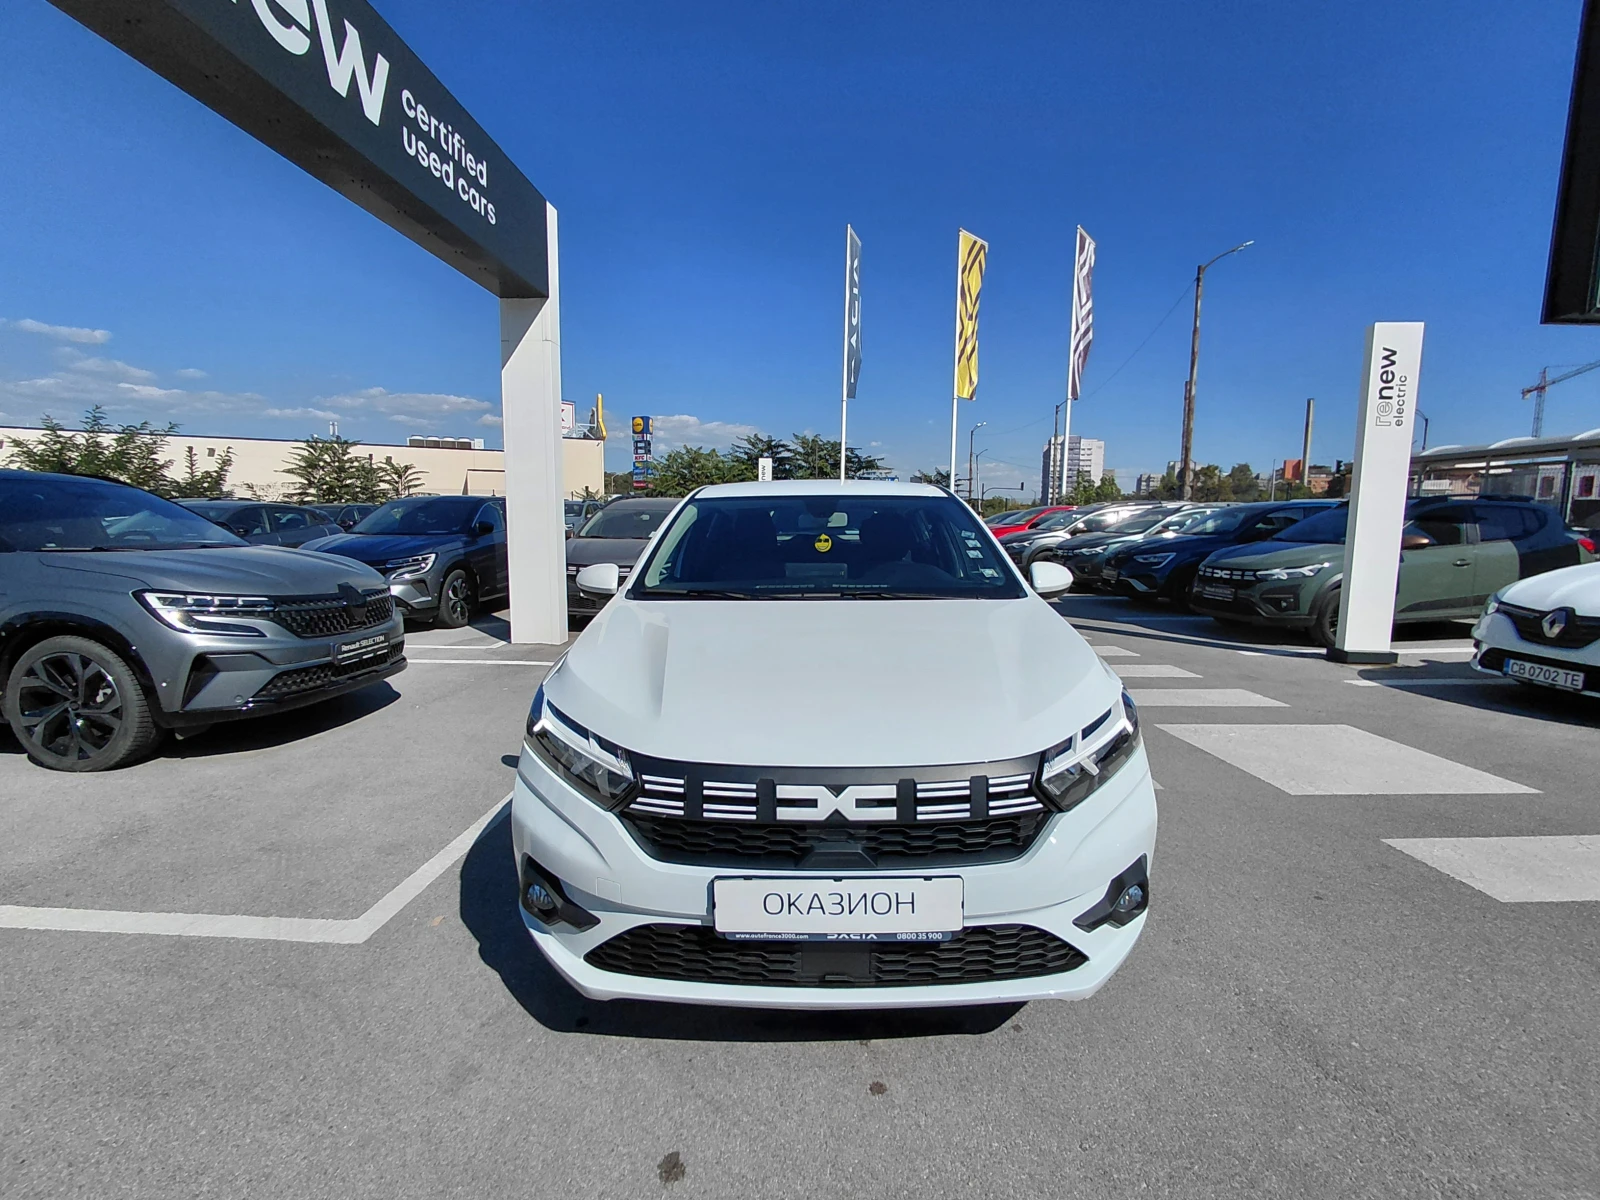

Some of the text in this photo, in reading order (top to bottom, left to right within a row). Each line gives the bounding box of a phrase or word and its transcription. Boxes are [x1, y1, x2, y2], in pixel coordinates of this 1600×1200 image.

[230, 0, 390, 126] ew
[401, 89, 487, 188] certified
[402, 126, 496, 225] used cars
[1375, 346, 1398, 427] renew
[1393, 375, 1408, 427] electric
[341, 635, 385, 652] Renault SELECTION
[1510, 661, 1581, 687] CB 0702 TE
[763, 892, 915, 915] ОКАЗИОН
[735, 932, 809, 940] www.autofrance3000.com
[896, 932, 917, 940] 0800
[917, 932, 927, 940] 35
[927, 932, 943, 940] 900
